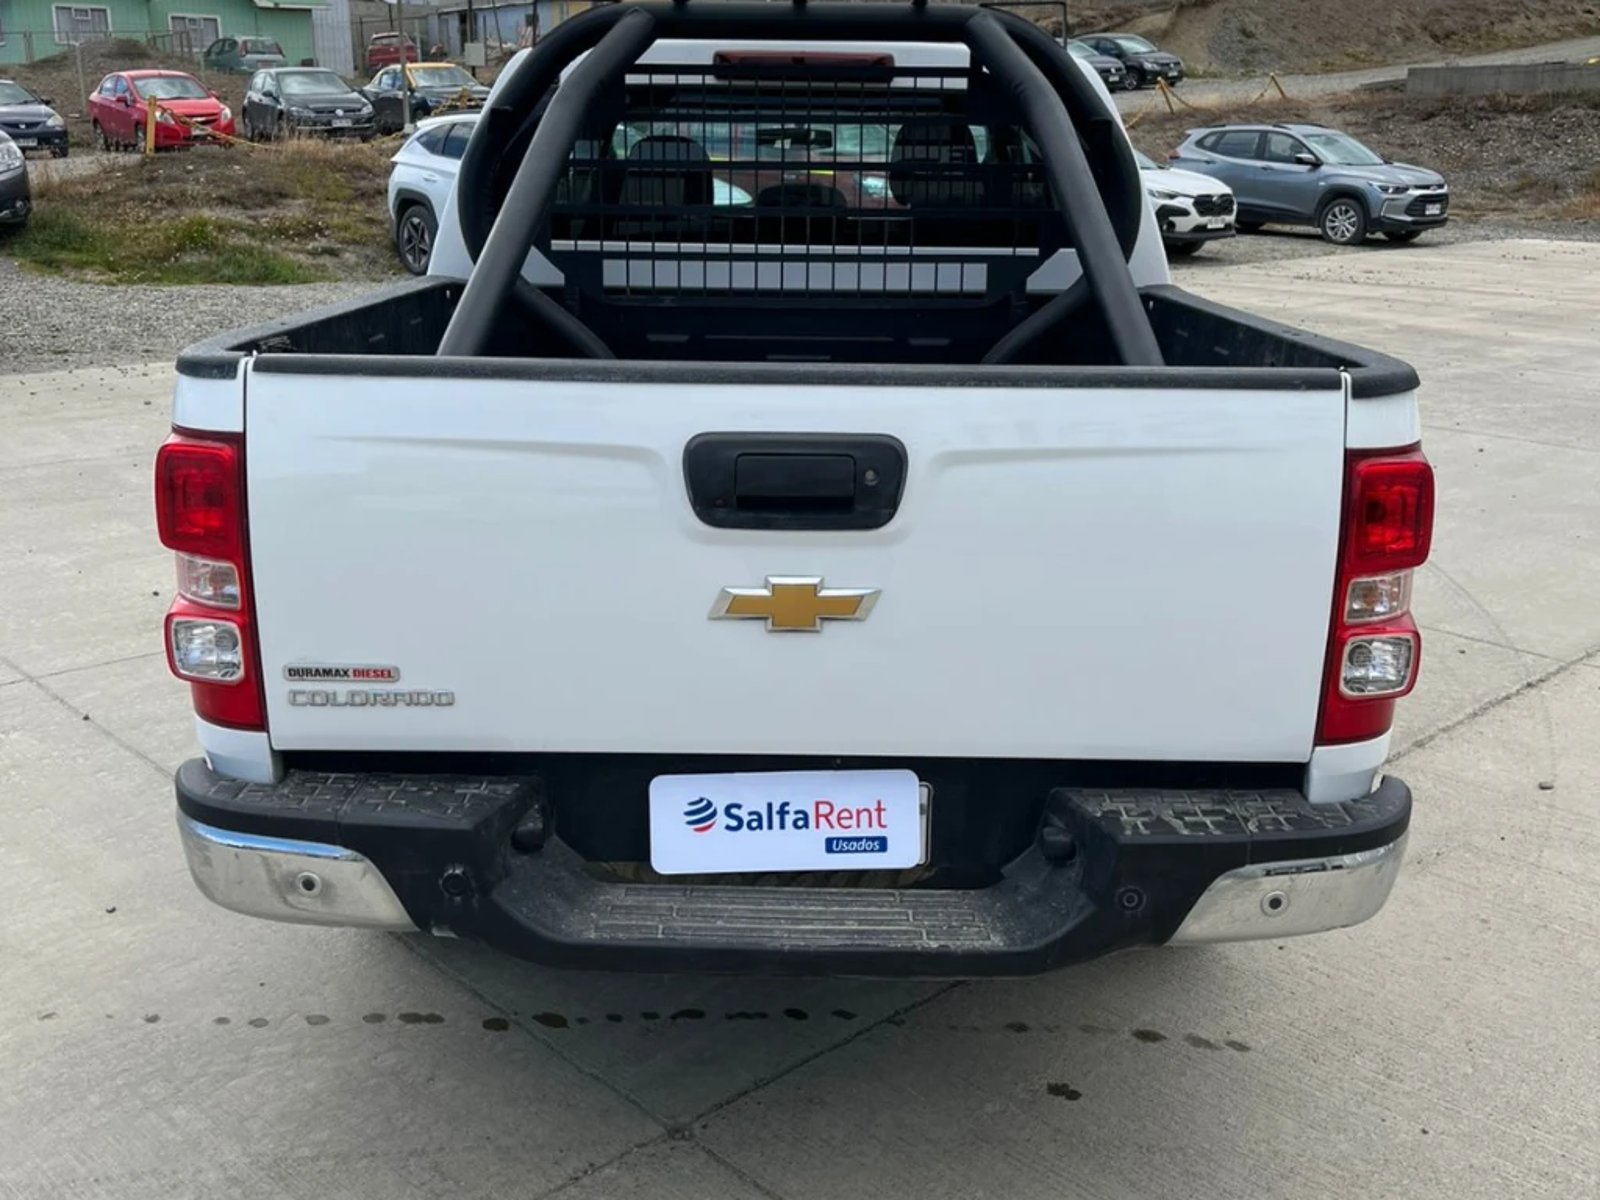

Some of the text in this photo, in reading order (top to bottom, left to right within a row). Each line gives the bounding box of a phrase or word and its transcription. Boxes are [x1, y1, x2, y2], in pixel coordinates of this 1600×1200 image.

[288, 667, 395, 679] DURAMAX DIESEL
[288, 689, 455, 707] COLORADO
[723, 799, 888, 832] SalfaRent
[832, 838, 880, 852] Usados
